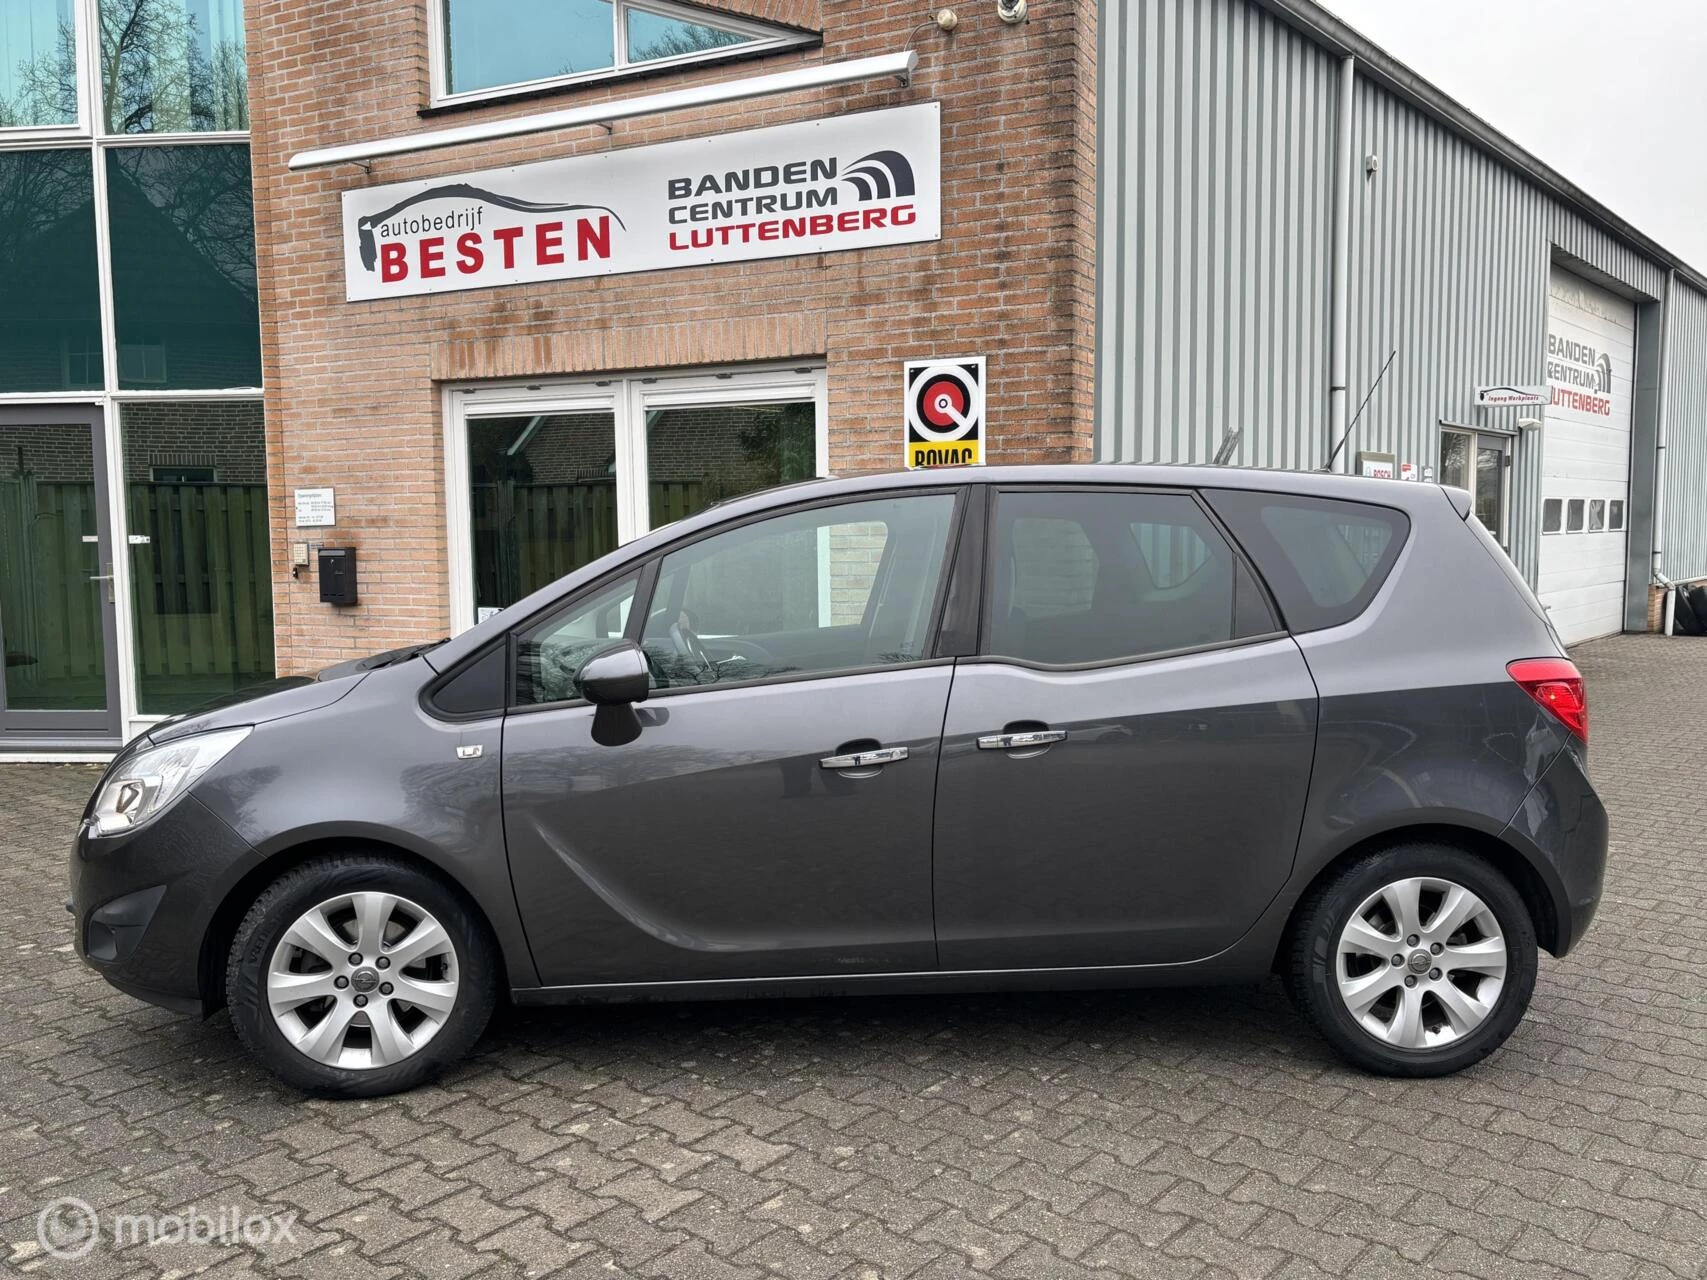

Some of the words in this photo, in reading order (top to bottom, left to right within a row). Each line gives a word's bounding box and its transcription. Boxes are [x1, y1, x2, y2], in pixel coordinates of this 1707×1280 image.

[668, 157, 837, 200] BANDEN
[380, 206, 484, 238] autobedrijf
[668, 187, 838, 224] CENTRUM
[669, 204, 916, 251] LUTTENBERG
[380, 215, 611, 283] BESTEN
[1548, 333, 1596, 367] BANDEN
[1551, 386, 1611, 416] UTTENBERG
